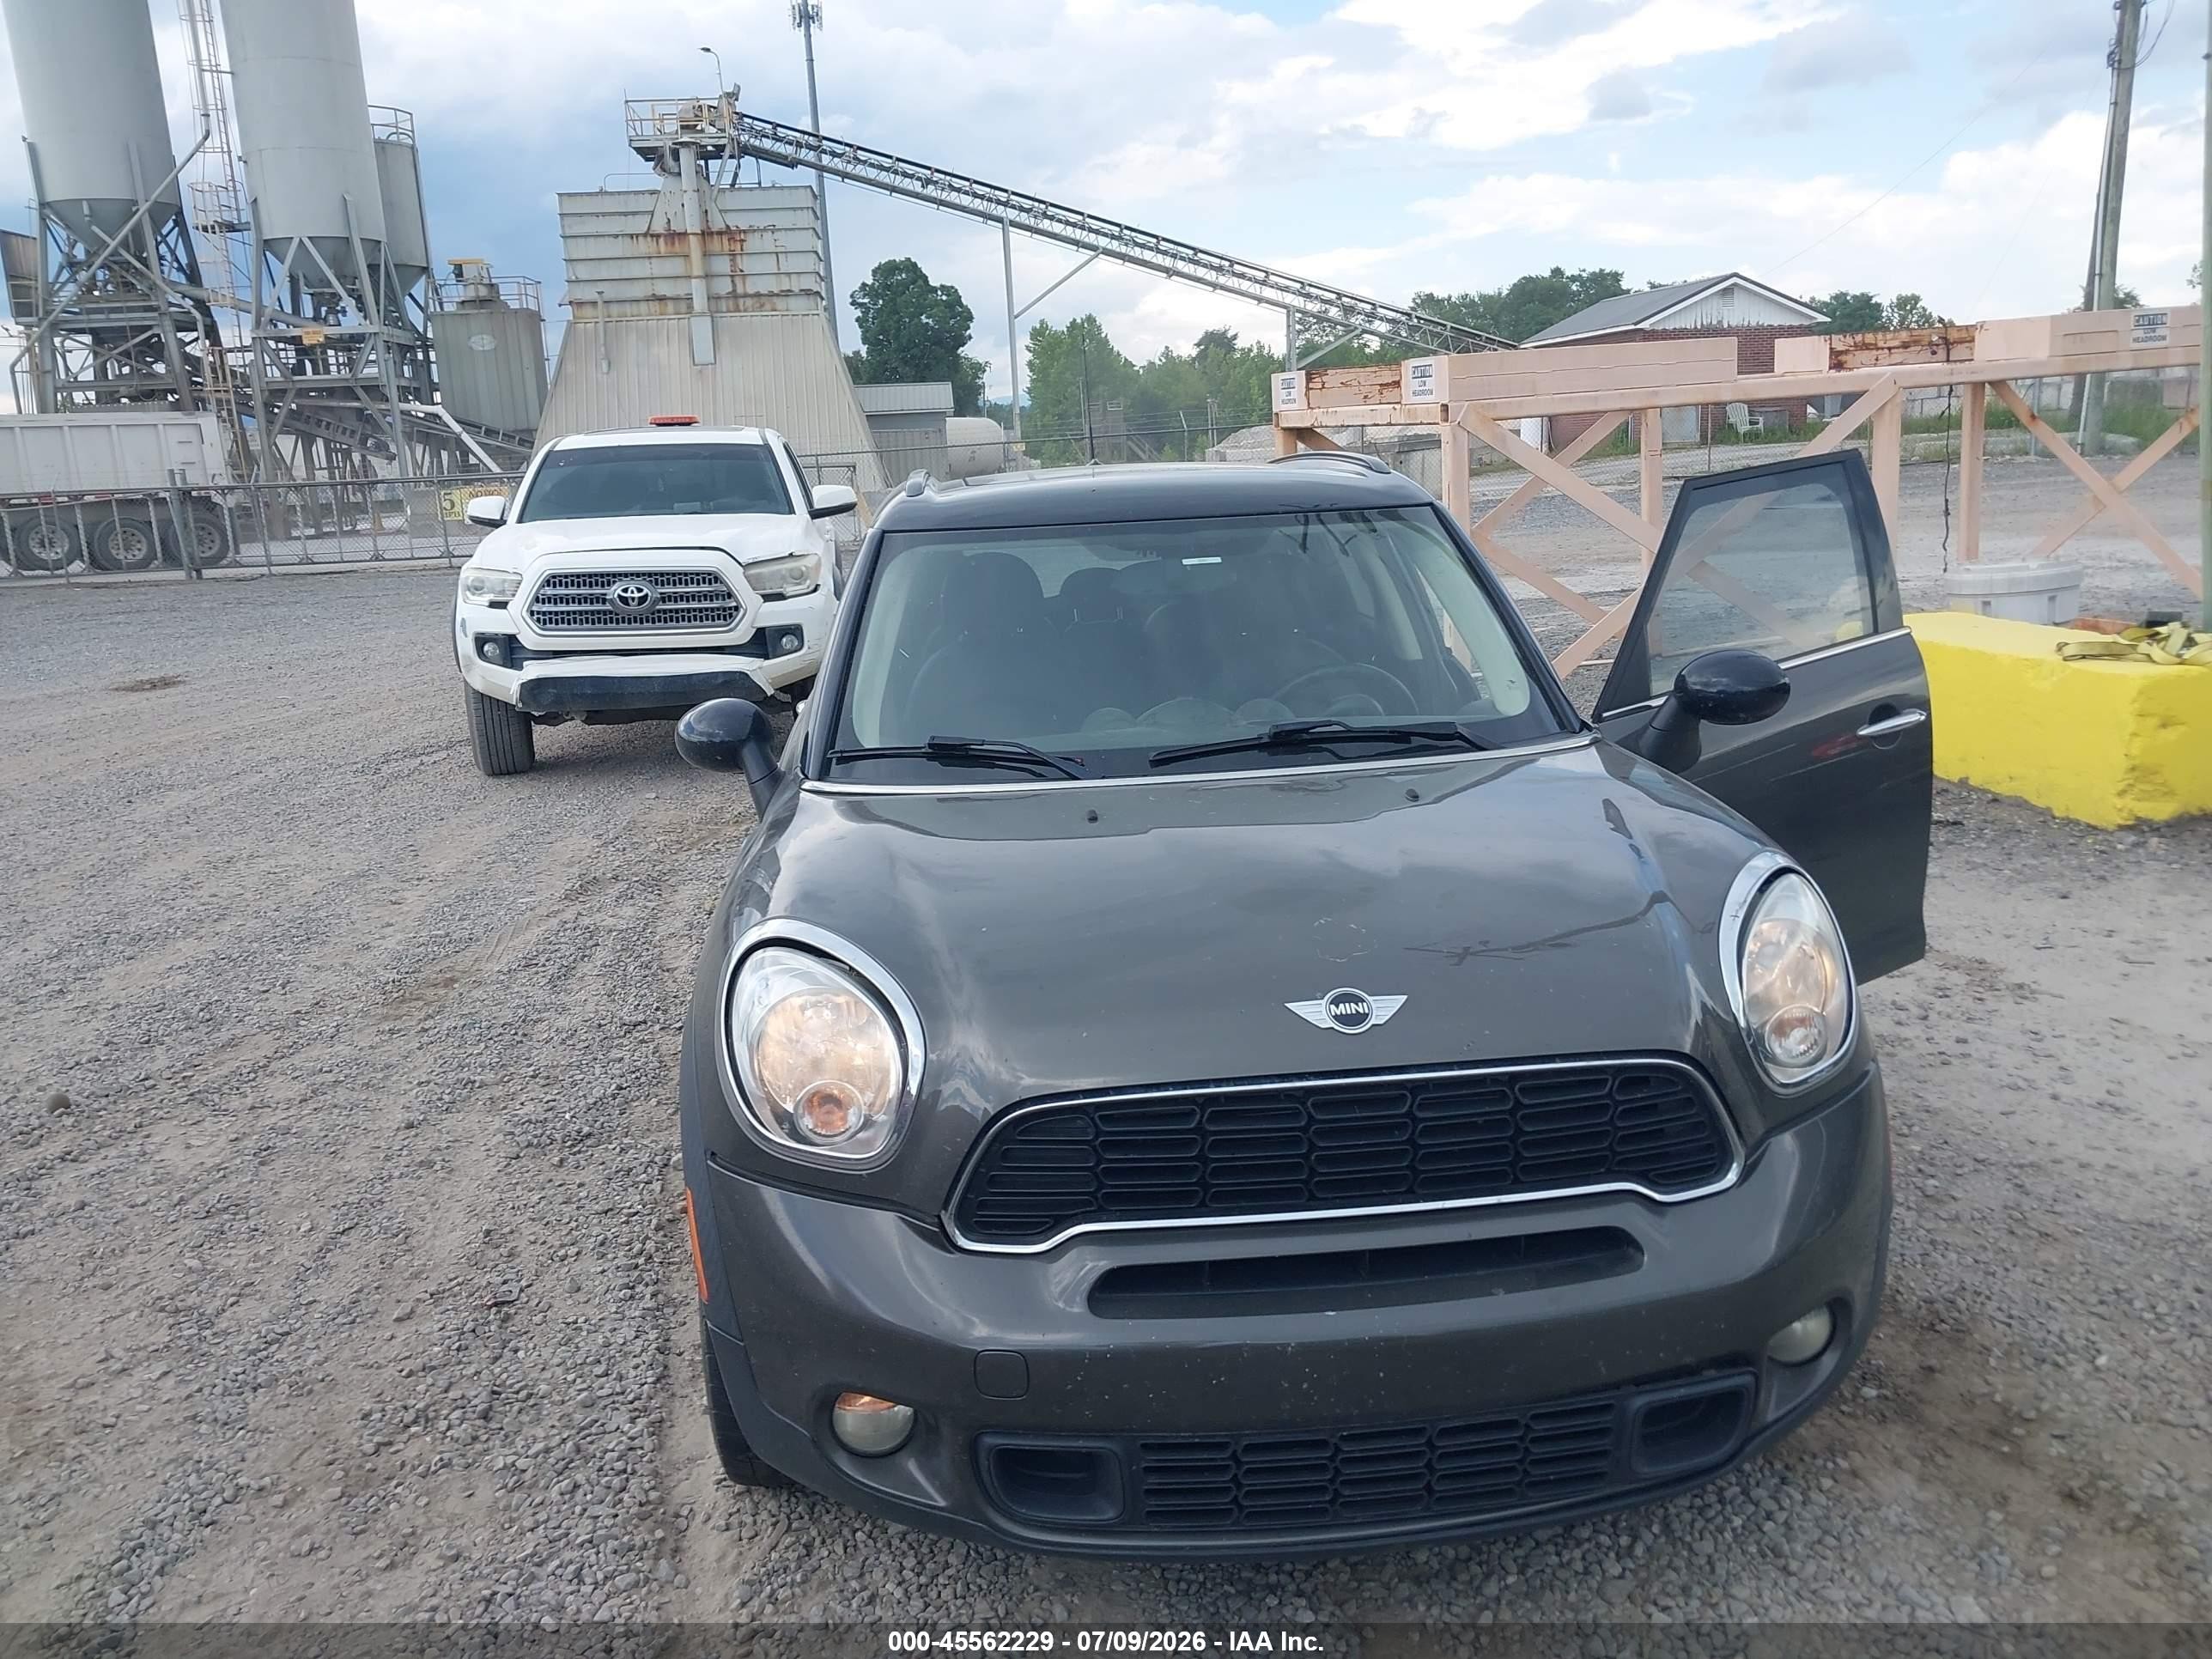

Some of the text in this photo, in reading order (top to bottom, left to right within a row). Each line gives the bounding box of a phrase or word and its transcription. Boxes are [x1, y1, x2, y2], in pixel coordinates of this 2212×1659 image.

[2134, 314, 2167, 325] CAUTION
[2132, 335, 2167, 343] HEADROOM
[1412, 365, 1432, 378] CAUTION
[443, 492, 455, 511] 5
[1329, 1001, 1370, 1017] MINI
